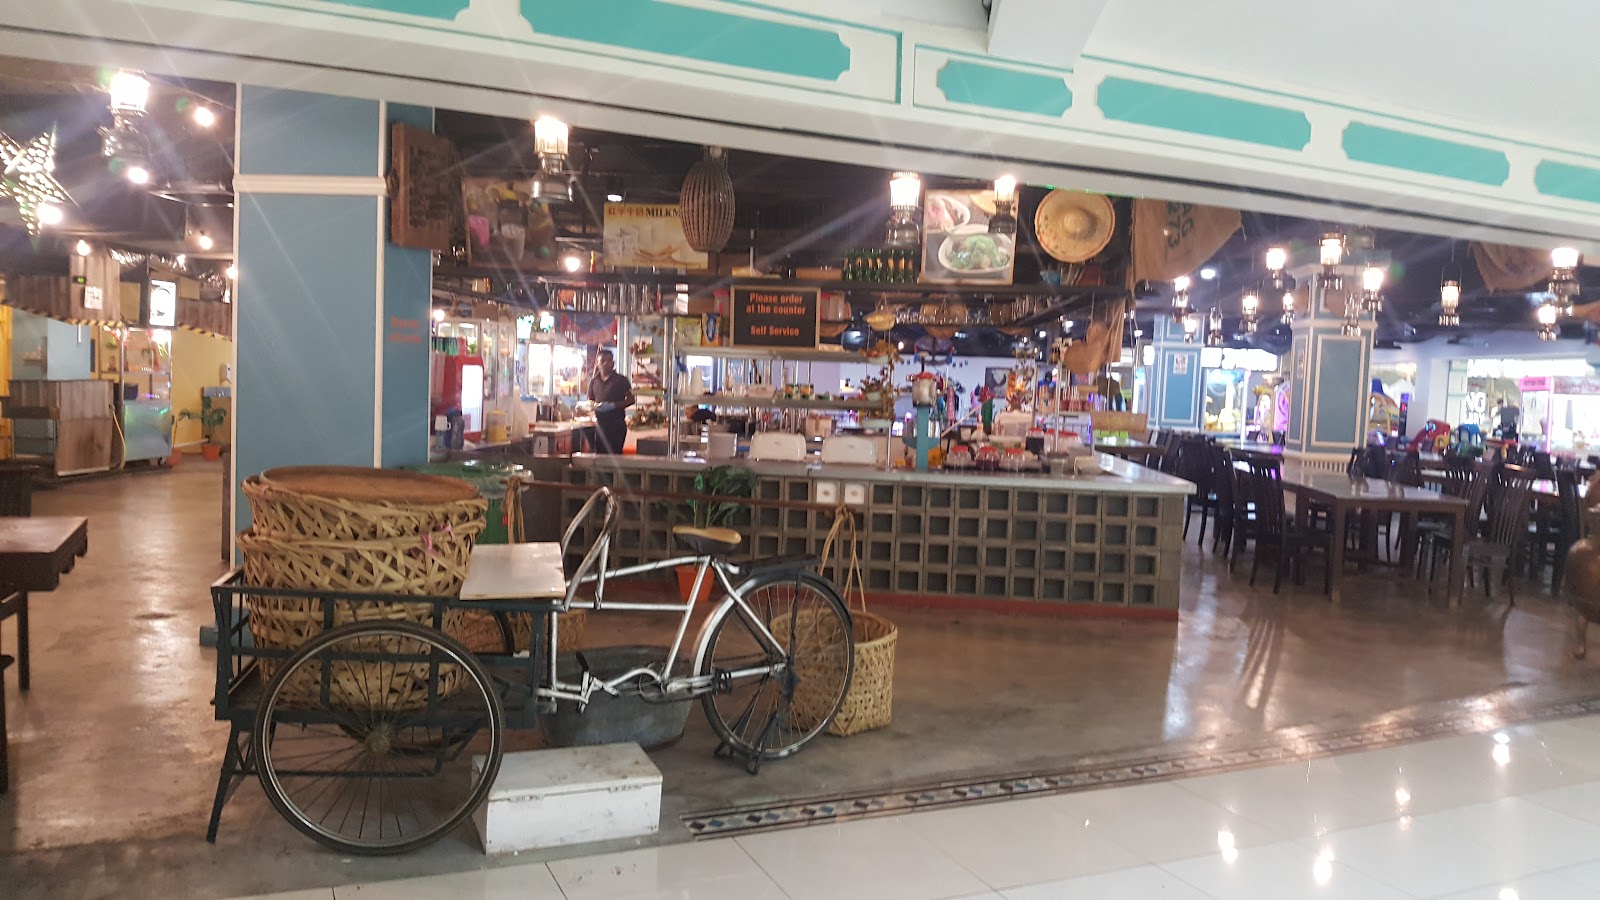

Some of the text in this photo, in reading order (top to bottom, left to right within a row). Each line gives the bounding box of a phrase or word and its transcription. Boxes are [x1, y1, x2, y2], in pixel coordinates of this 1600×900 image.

[750, 292, 803, 304] Please order
[746, 304, 806, 315] at the counter
[750, 325, 800, 336] Self Service
